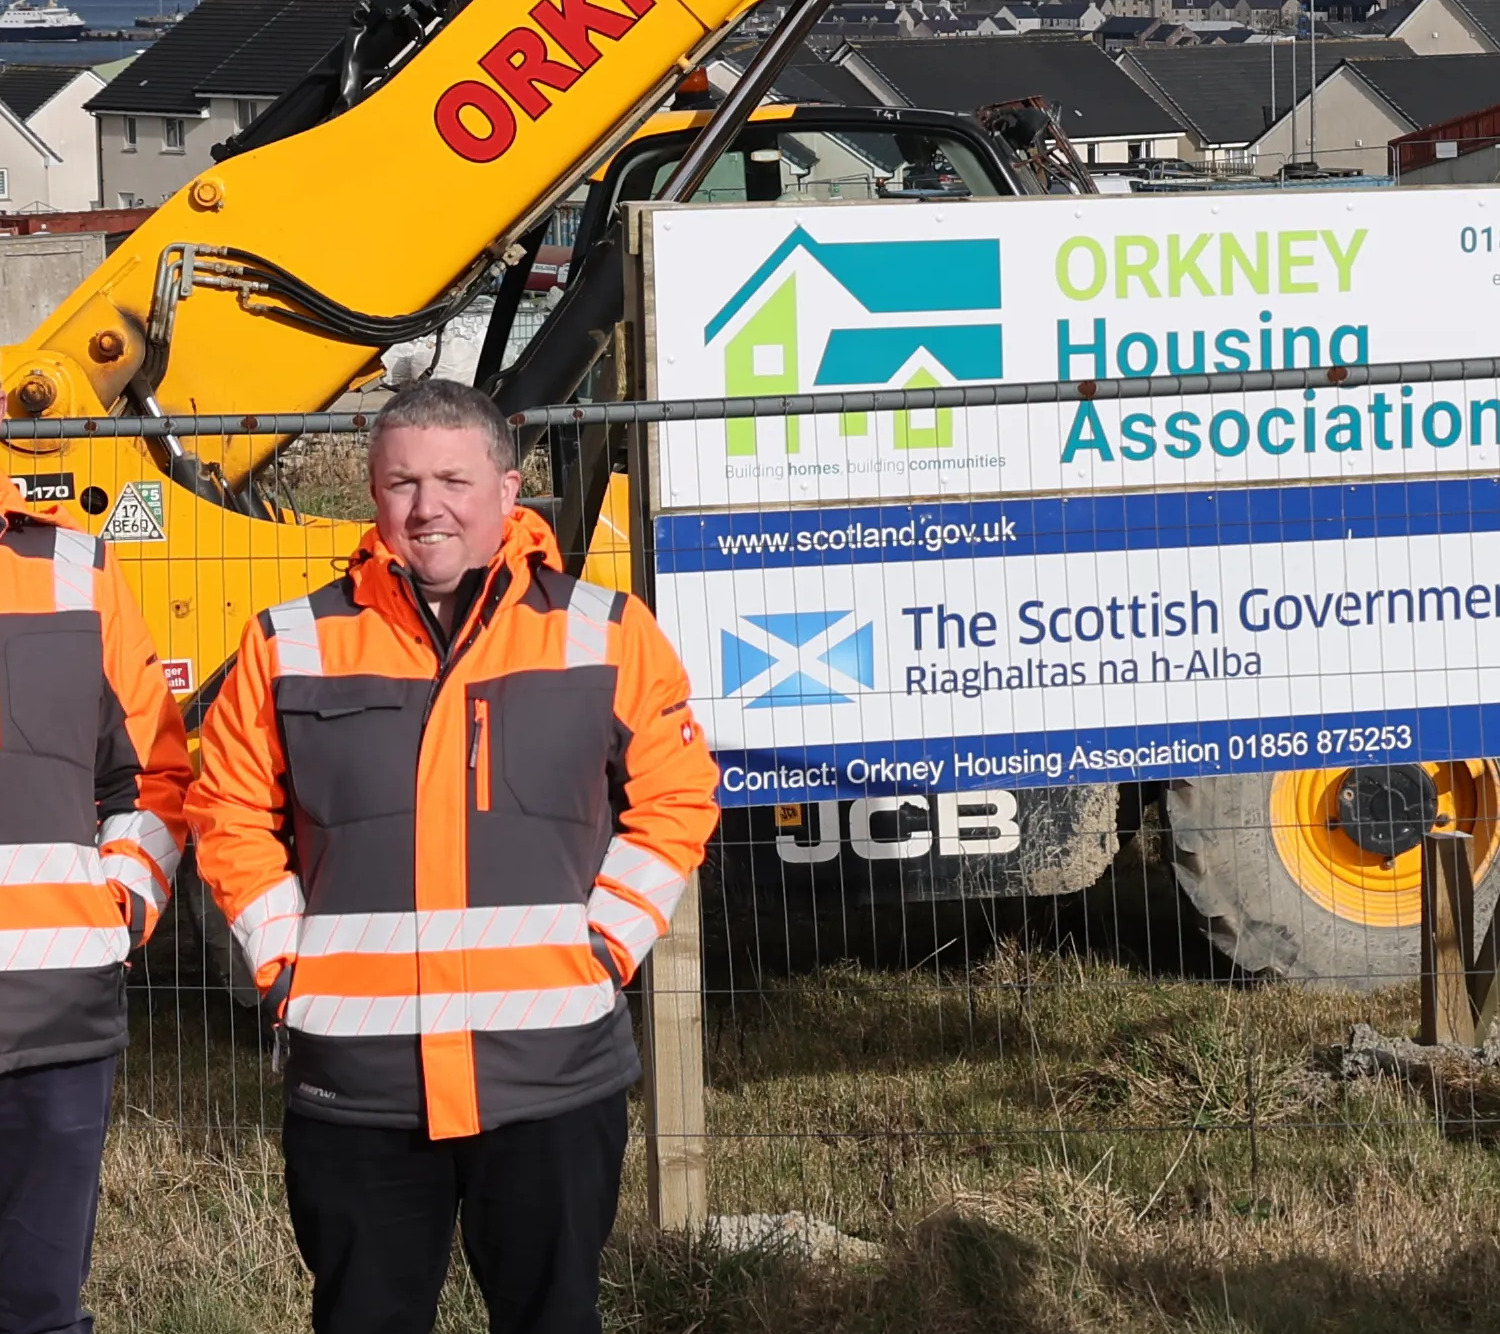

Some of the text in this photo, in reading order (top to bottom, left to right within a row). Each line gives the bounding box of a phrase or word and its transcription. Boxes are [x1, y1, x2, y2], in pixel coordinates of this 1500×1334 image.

[1055, 228, 1369, 302] ORKNEY
[1056, 310, 1369, 388] Housing
[725, 463, 784, 479] Building
[847, 459, 905, 475] building
[909, 454, 1006, 471] communities
[122, 504, 138, 518] 17
[150, 489, 160, 501] 5
[717, 515, 1017, 555] www.scotland.gov.uk
[902, 604, 997, 651] The
[1018, 590, 1219, 647] Scottish
[164, 667, 183, 677] ger
[905, 645, 1263, 699] Riaghaltas na h-Alba
[723, 724, 1412, 792] Contact: Orkney Housing Association 01856 875253
[775, 788, 1021, 864] JCB
